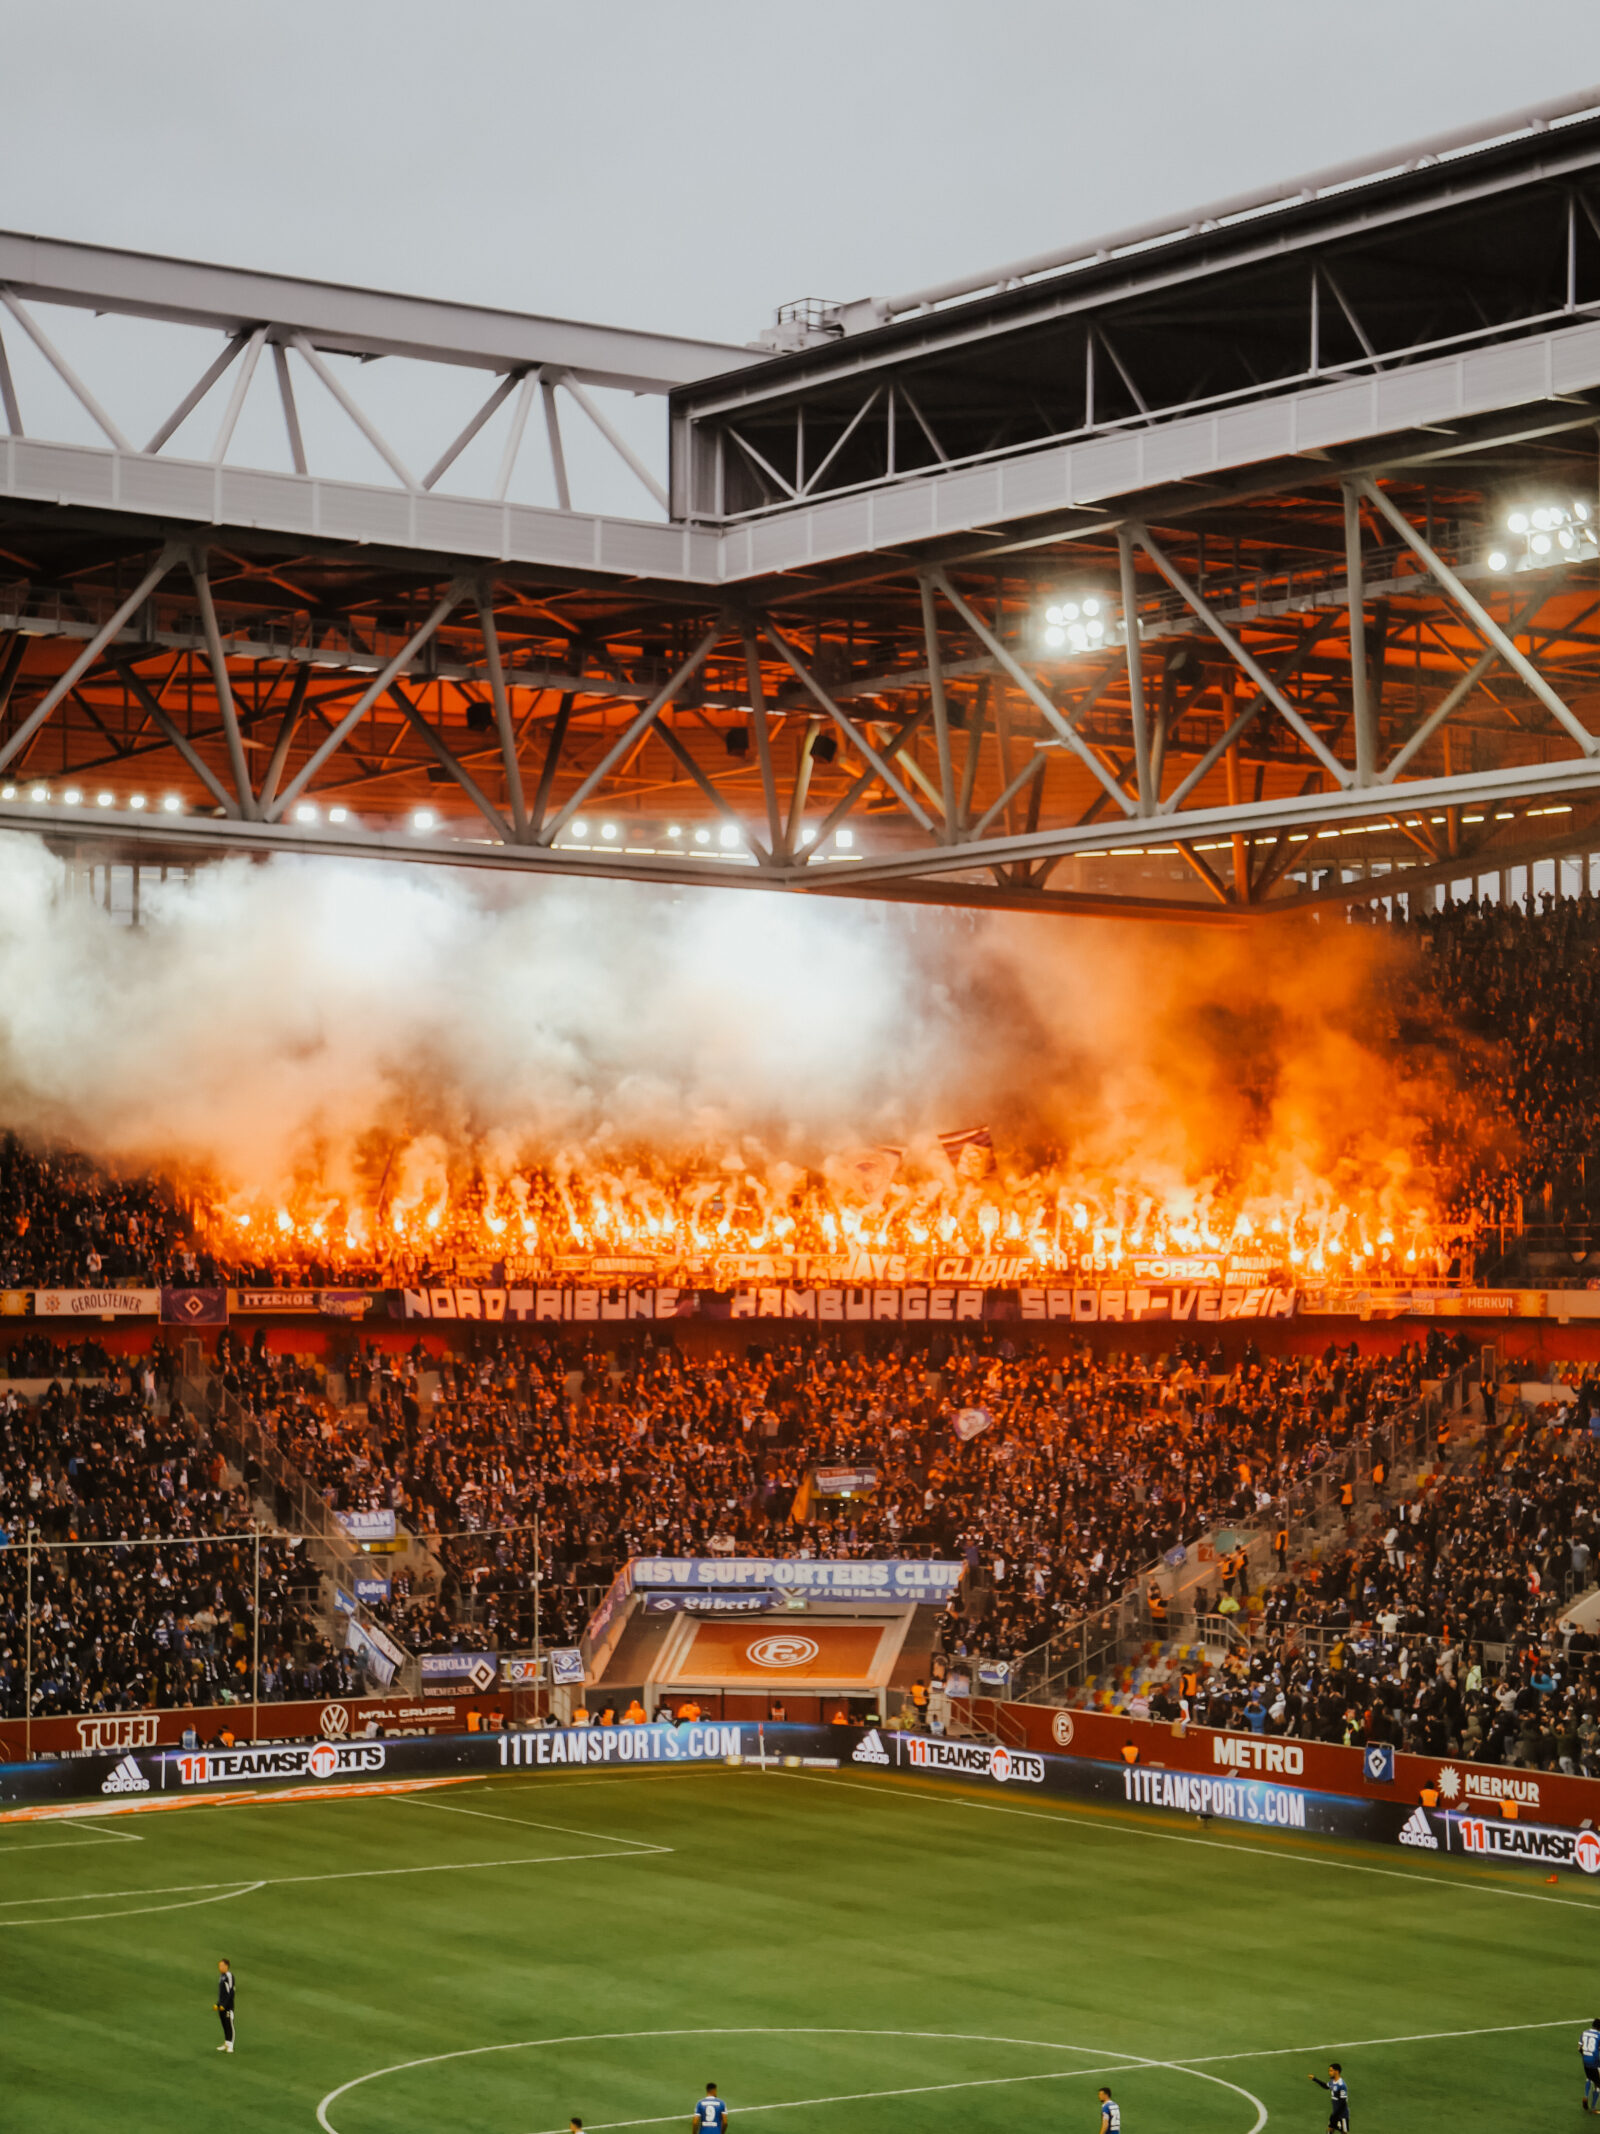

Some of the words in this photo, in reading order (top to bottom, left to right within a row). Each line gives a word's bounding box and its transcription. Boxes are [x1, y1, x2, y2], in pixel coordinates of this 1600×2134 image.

[1134, 1261, 1221, 1278] FORZA
[71, 1293, 142, 1313] GEROLSTEINER
[244, 1293, 314, 1306] ITZEHOE
[730, 1288, 984, 1320] HAMBURGER
[1020, 1287, 1296, 1321] SPORT-VEREIN
[1467, 1297, 1514, 1309] MERKUR
[634, 1561, 692, 1582] HSV
[698, 1562, 889, 1585] SUPPORTERS
[399, 1706, 456, 1717] GRUPPE
[78, 1715, 160, 1750] TUFFI
[499, 1727, 741, 1766] 11TEAMSPORTS.COM
[1213, 1736, 1304, 1775] METRO
[102, 1779, 150, 1794] adidas
[1465, 1774, 1540, 1802] MERKUR
[1123, 1767, 1306, 1827] 11TEAMSPORTS.COM
[1399, 1831, 1438, 1849] adidas
[705, 2105, 716, 2122] 9
